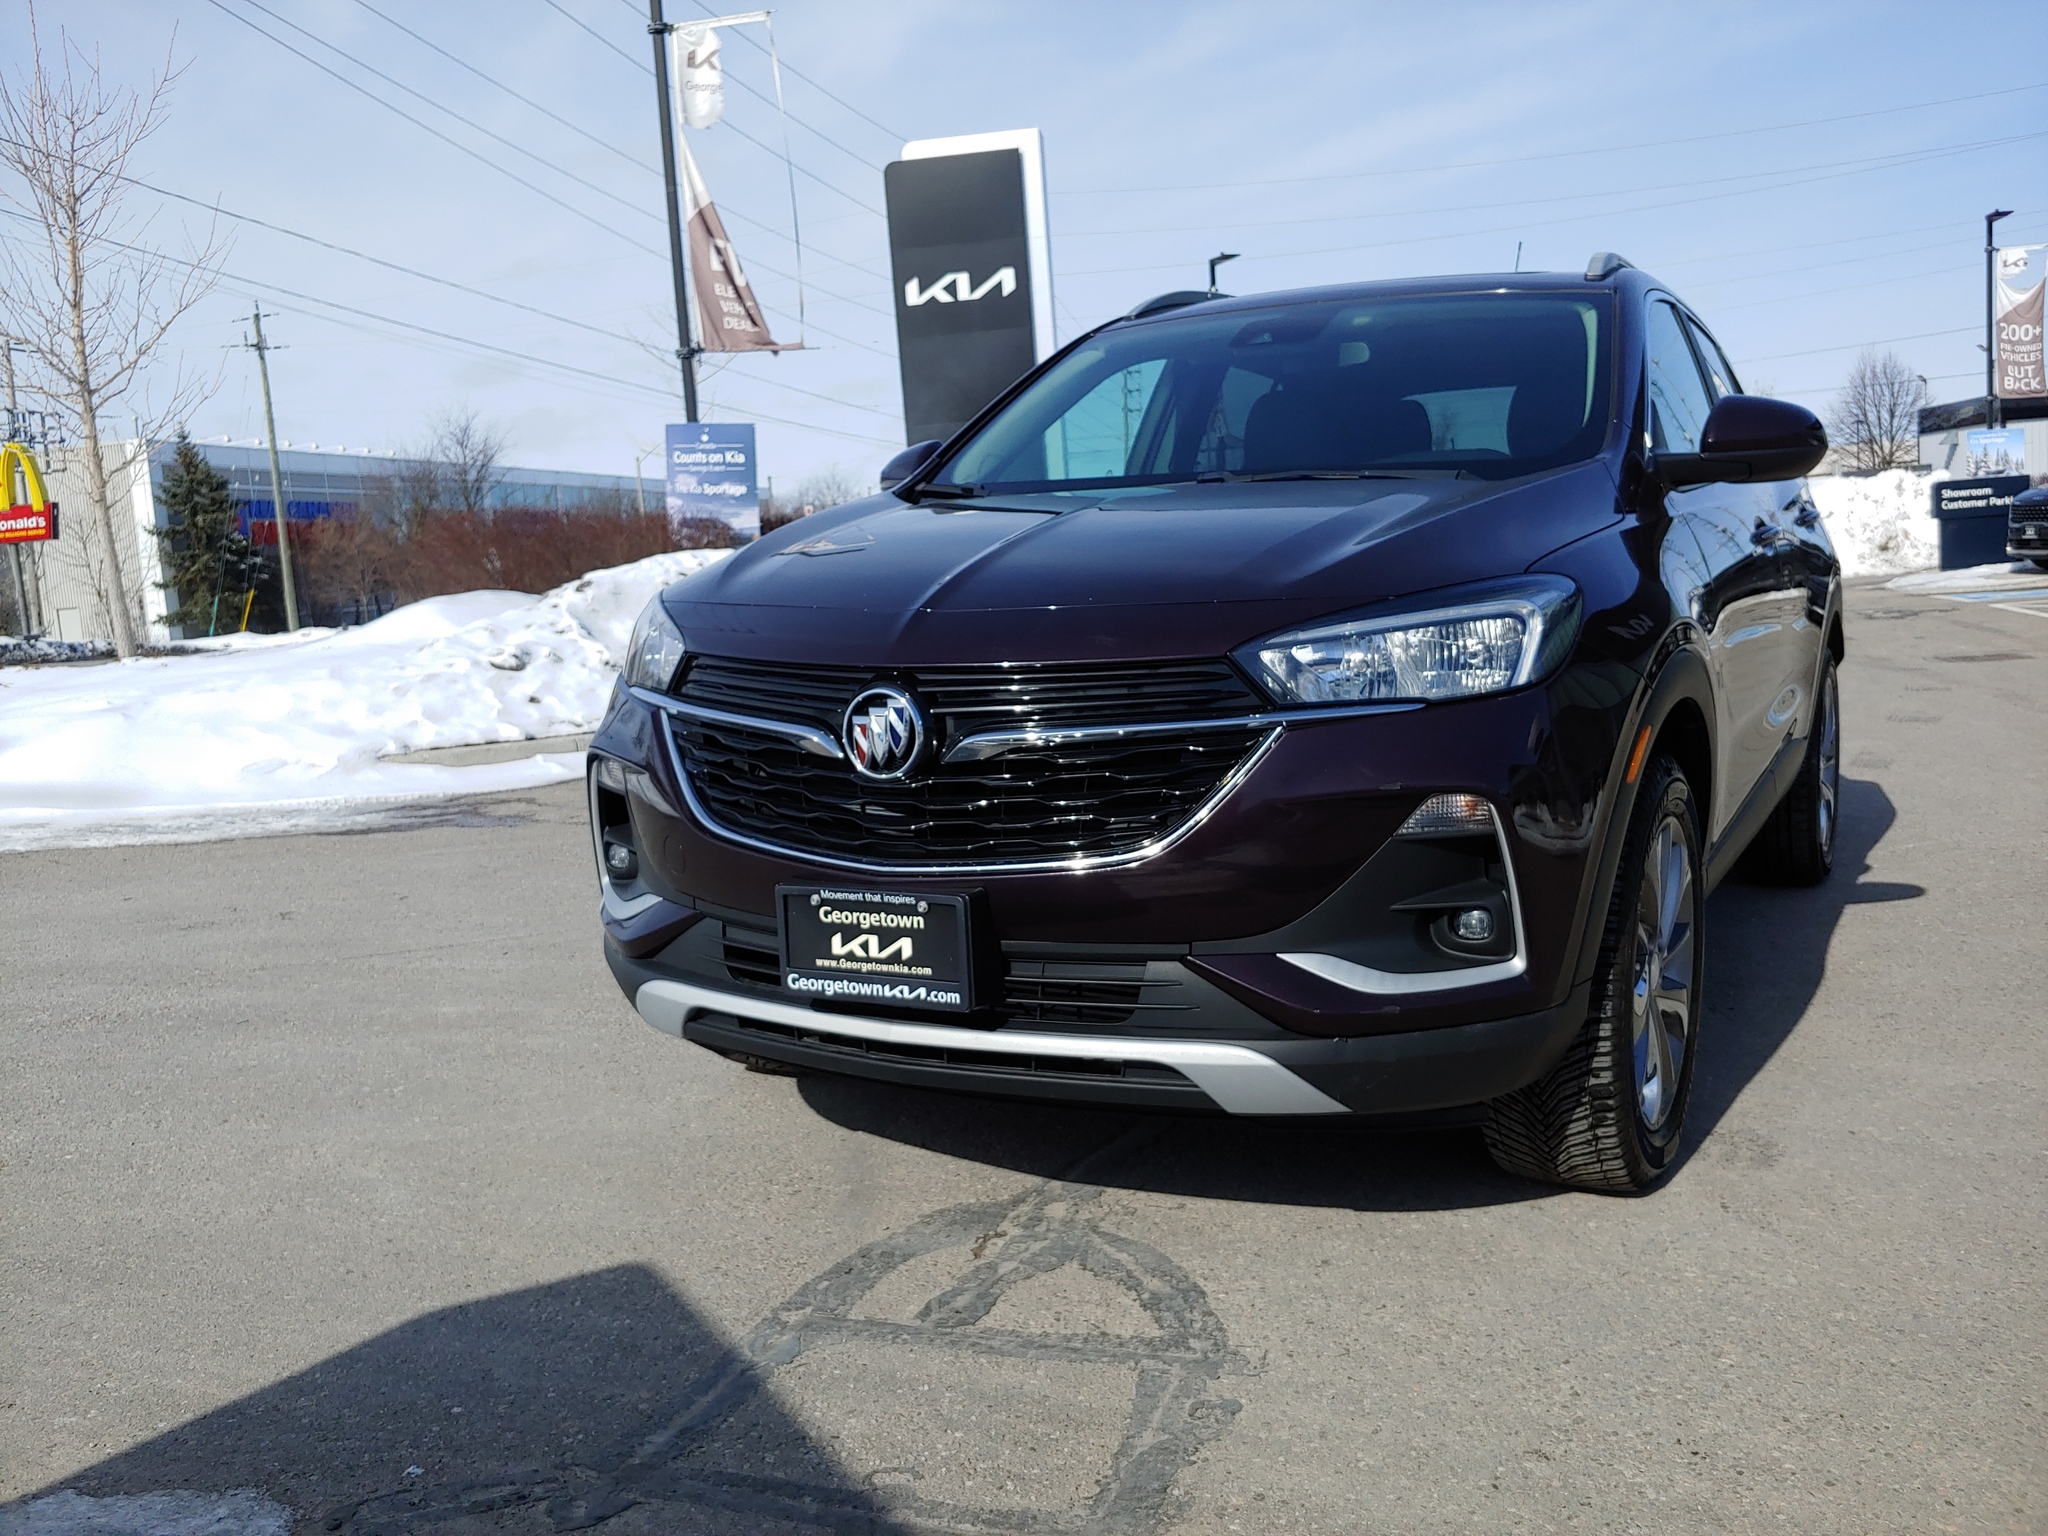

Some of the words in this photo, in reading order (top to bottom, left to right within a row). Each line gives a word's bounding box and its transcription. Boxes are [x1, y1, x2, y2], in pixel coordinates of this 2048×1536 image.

[685, 80, 724, 95] George
[904, 265, 1018, 307] KIA
[1999, 322, 2042, 341] 200+
[2000, 342, 2042, 352] PRE-OWNED
[2000, 350, 2042, 362] VEHICLES
[2007, 364, 2036, 378] OUT
[2003, 376, 2042, 390] BACK
[672, 450, 708, 464] Counts
[708, 452, 724, 464] on
[724, 450, 746, 464] Kia
[702, 482, 748, 497] Sportage
[1941, 488, 1992, 498] Showroom
[1941, 500, 1987, 510] Customer
[0, 516, 46, 531] onald's
[820, 889, 864, 902] Movement
[865, 893, 882, 903] that
[883, 894, 916, 906] inspires
[818, 906, 925, 930] Georgetown
[830, 931, 913, 961] KIA
[815, 958, 932, 976] www.Georgetownkia.com
